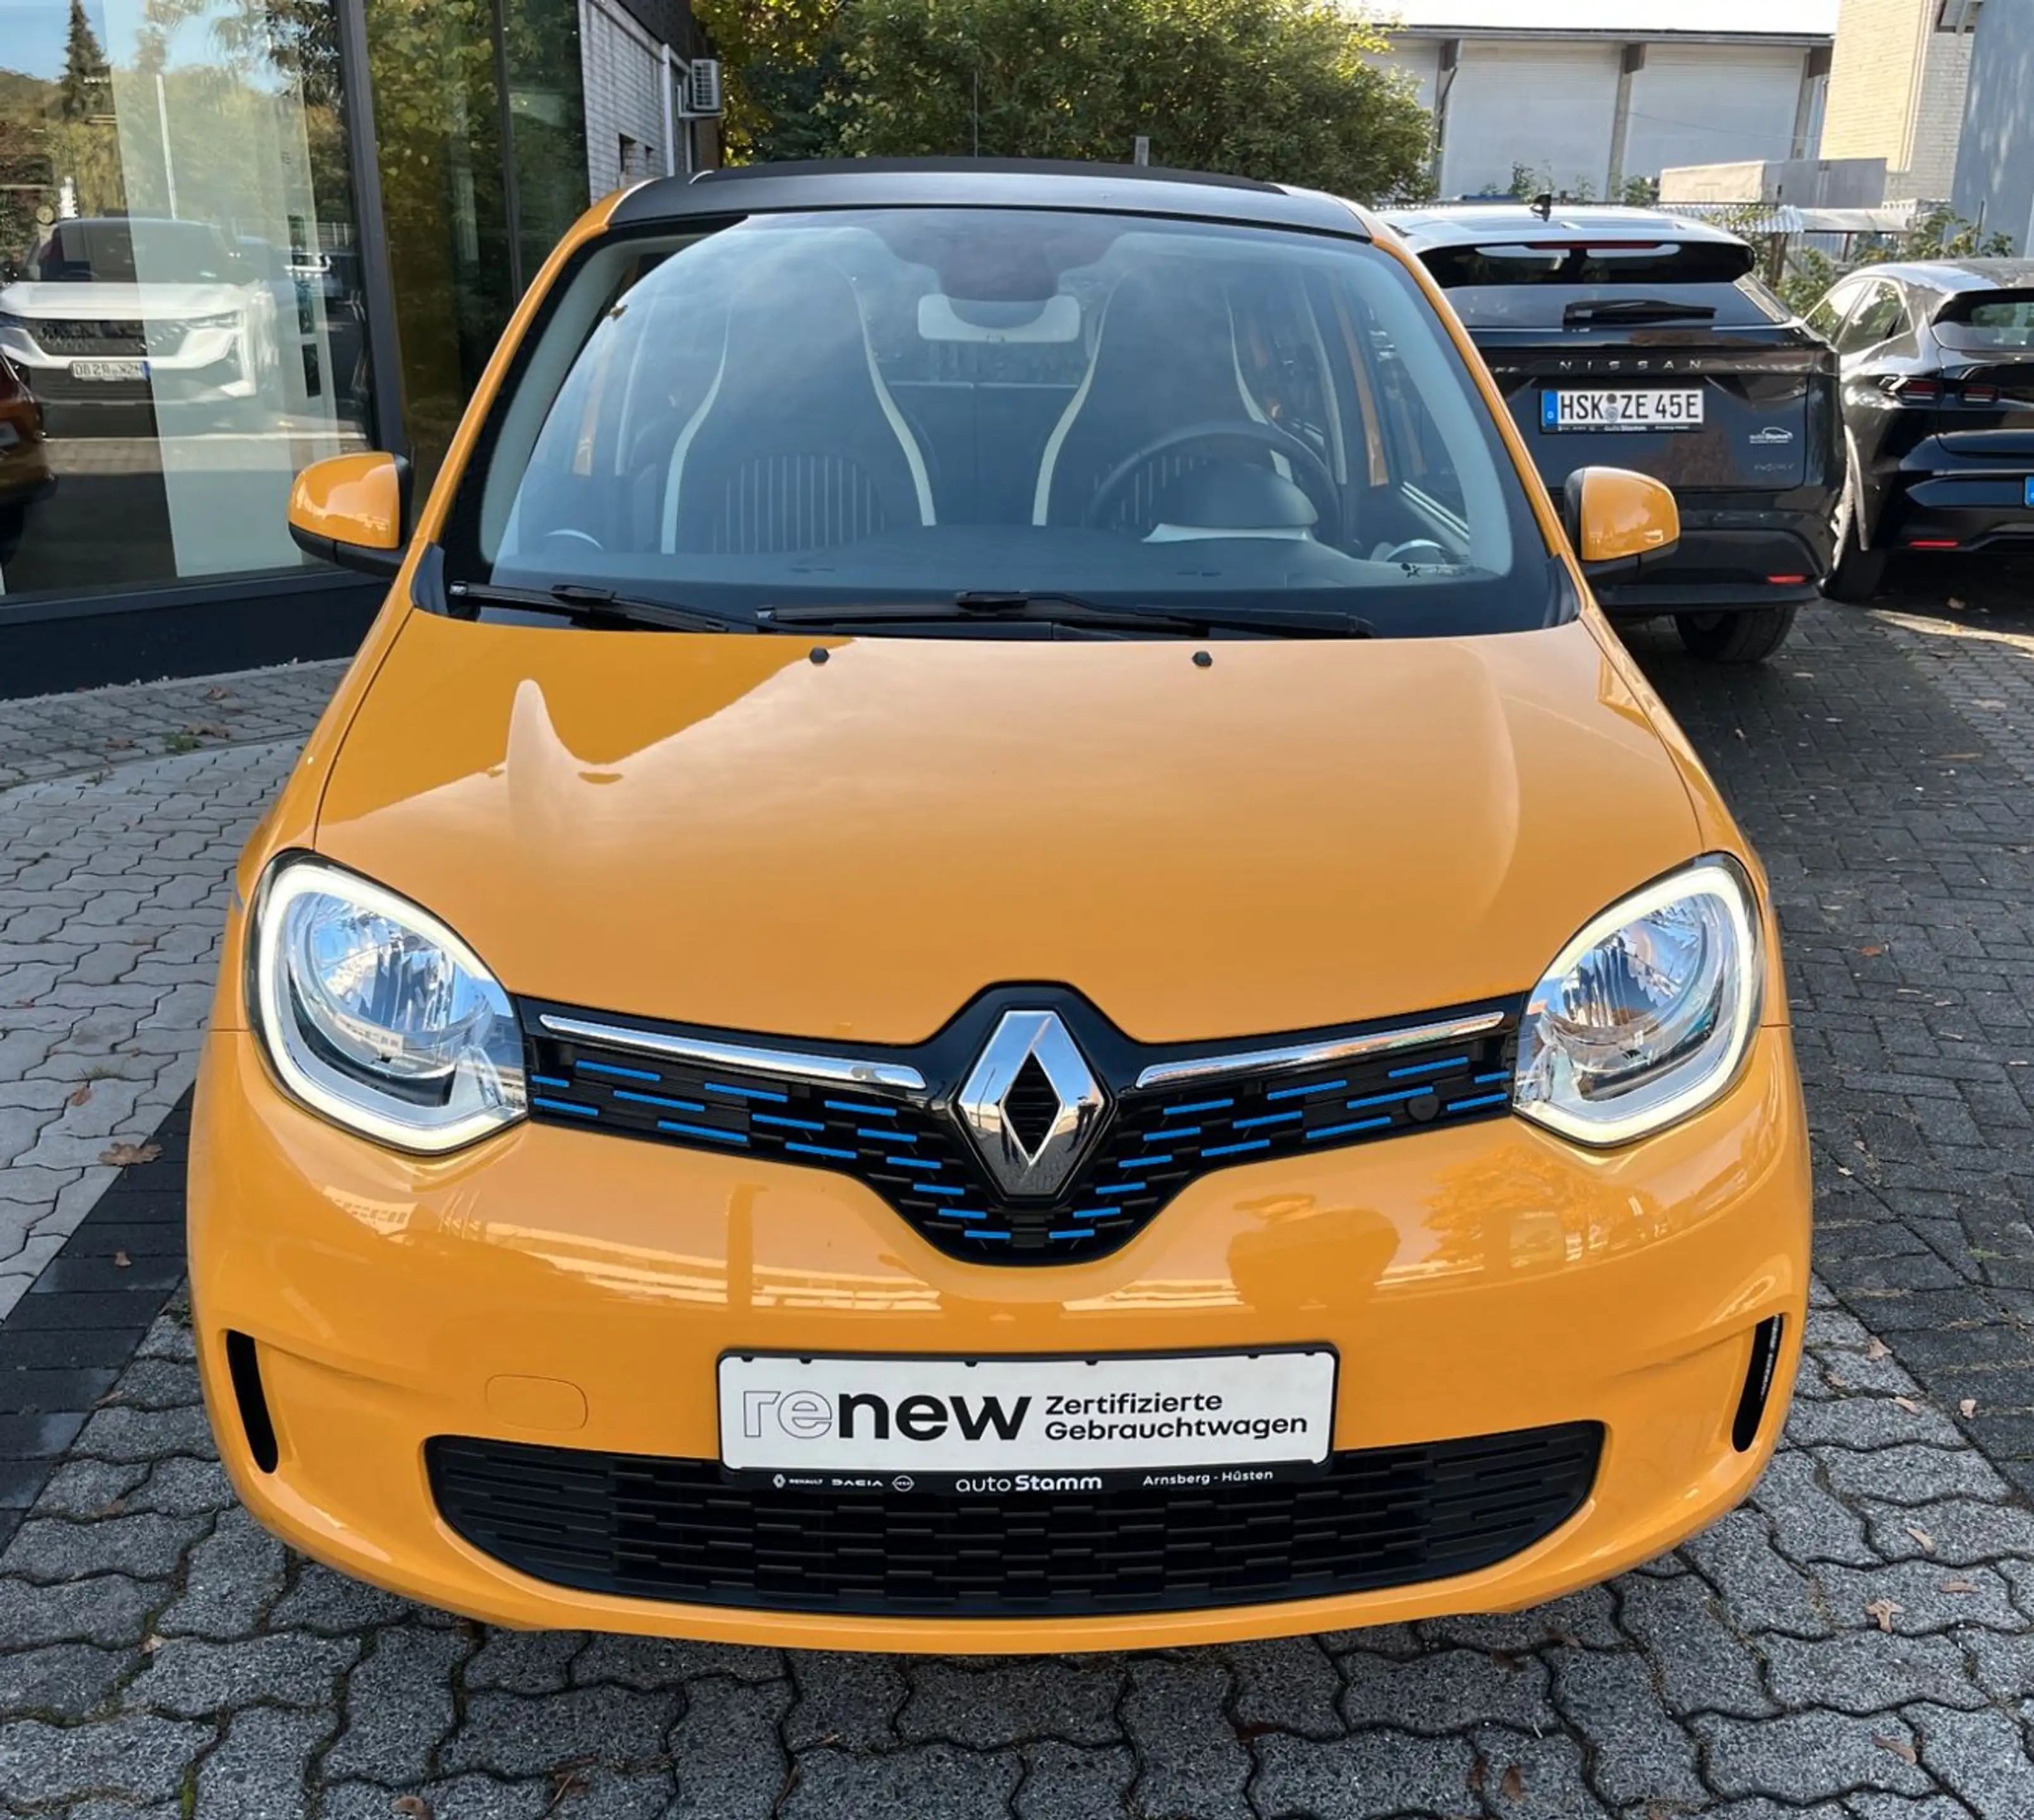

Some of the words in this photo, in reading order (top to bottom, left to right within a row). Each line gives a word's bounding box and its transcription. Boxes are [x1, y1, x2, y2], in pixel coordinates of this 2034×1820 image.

[1559, 360, 1702, 370] NISSAN
[1561, 394, 1604, 420] HSK
[1621, 394, 1648, 419] ZE
[1655, 394, 1699, 419] 45E
[1045, 1392, 1222, 1415] Zertifizierte
[743, 1390, 1033, 1441] renew
[1045, 1417, 1308, 1441] Gebrauchtwagen
[831, 1477, 884, 1488] DACIA
[1142, 1473, 1210, 1486] Arnsberg
[1221, 1469, 1274, 1483] Hüsten
